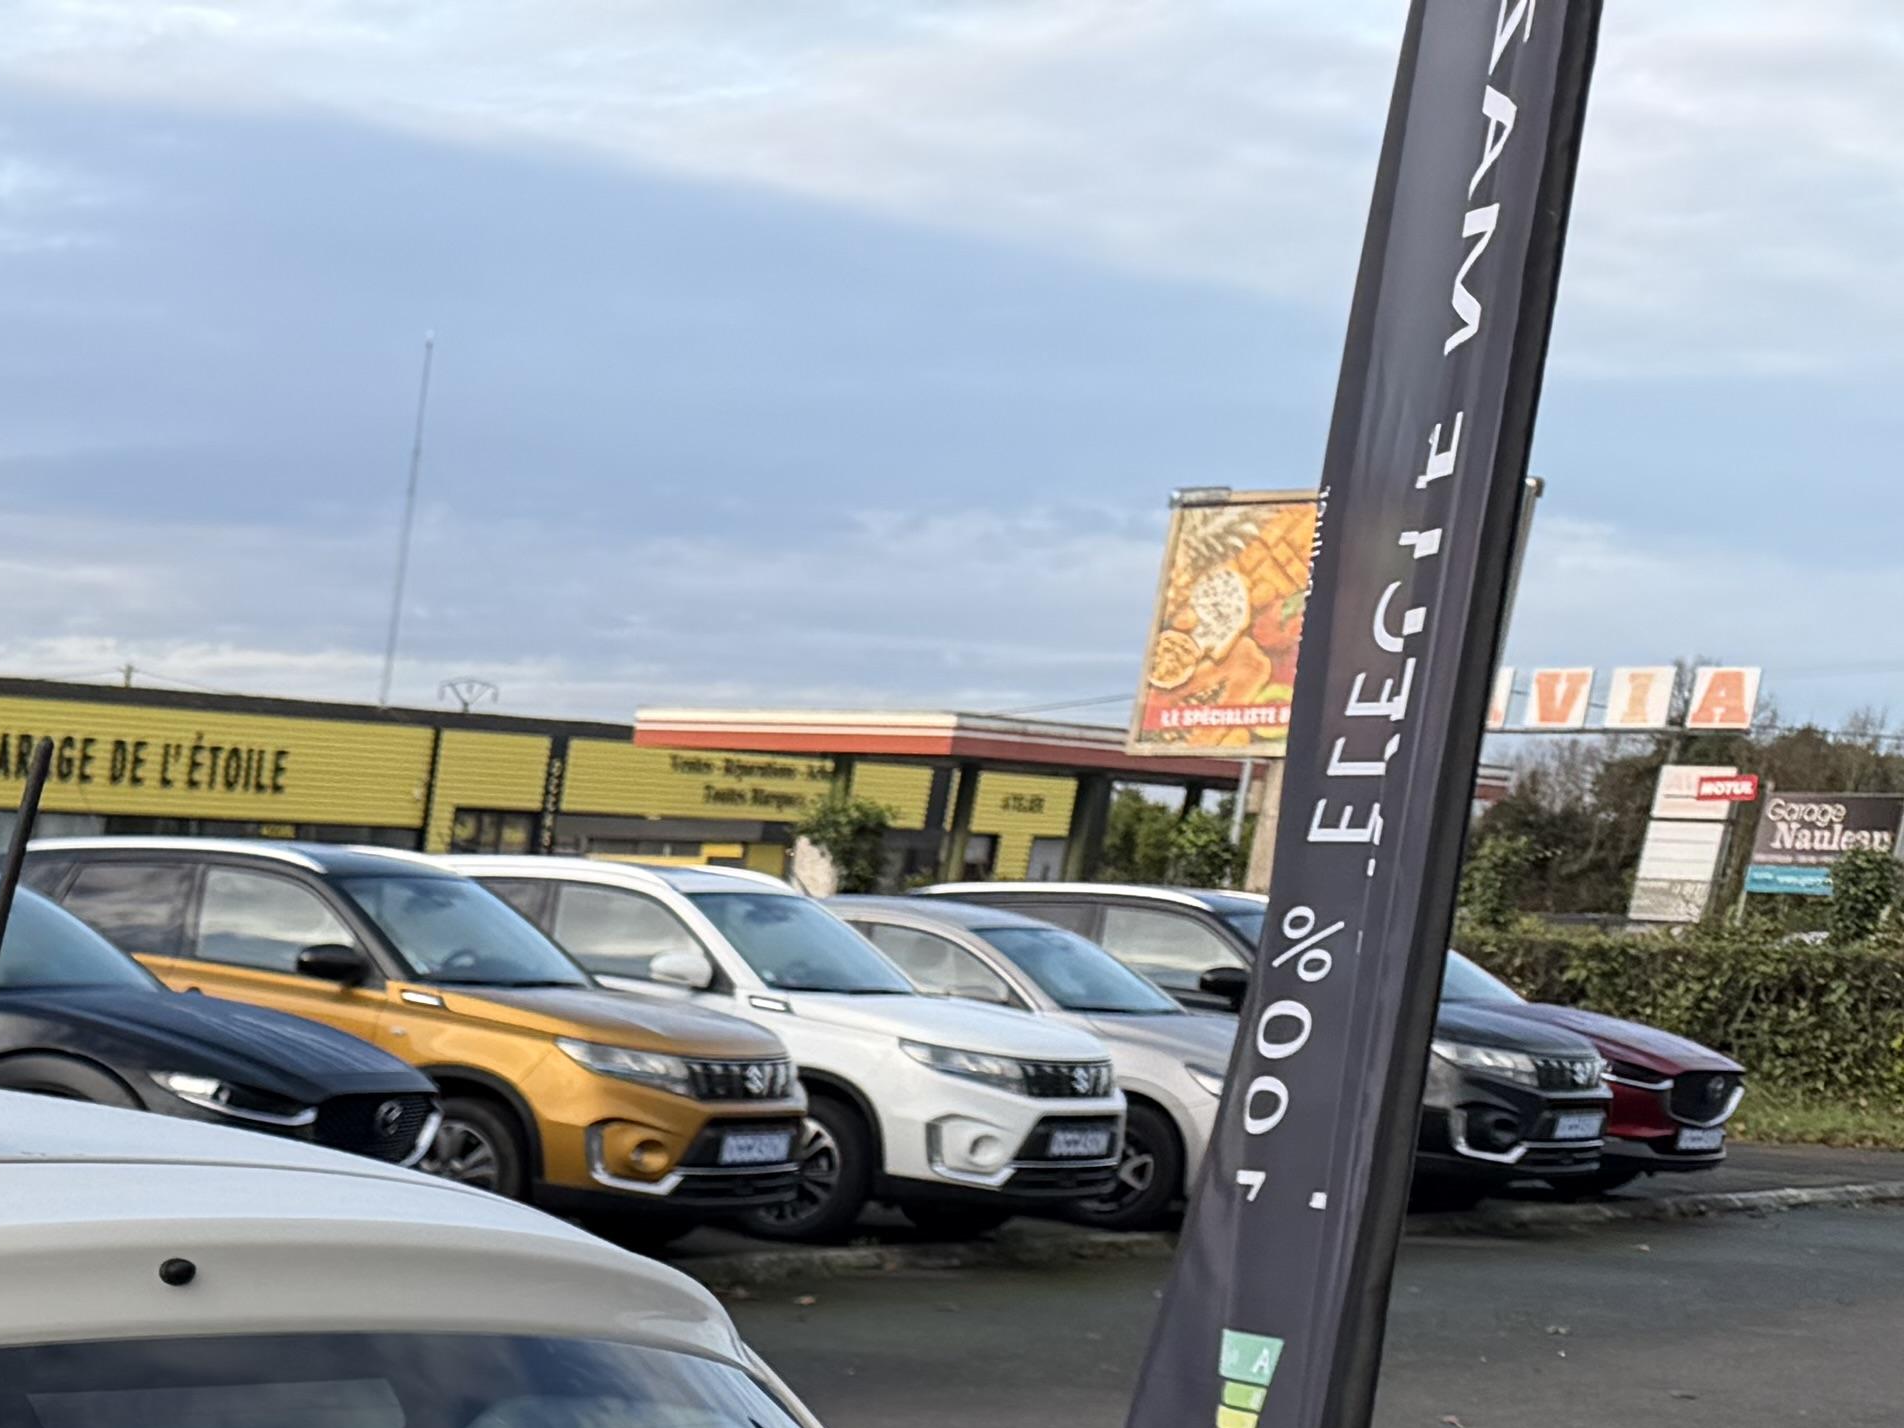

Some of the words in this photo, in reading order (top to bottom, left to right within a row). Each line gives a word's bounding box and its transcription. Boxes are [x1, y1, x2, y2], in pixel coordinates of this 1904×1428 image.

[109, 739, 148, 788] DE
[159, 730, 291, 795] L'ÉTOILE
[1700, 780, 1755, 797] MOTUL
[1766, 798, 1847, 827] Garage
